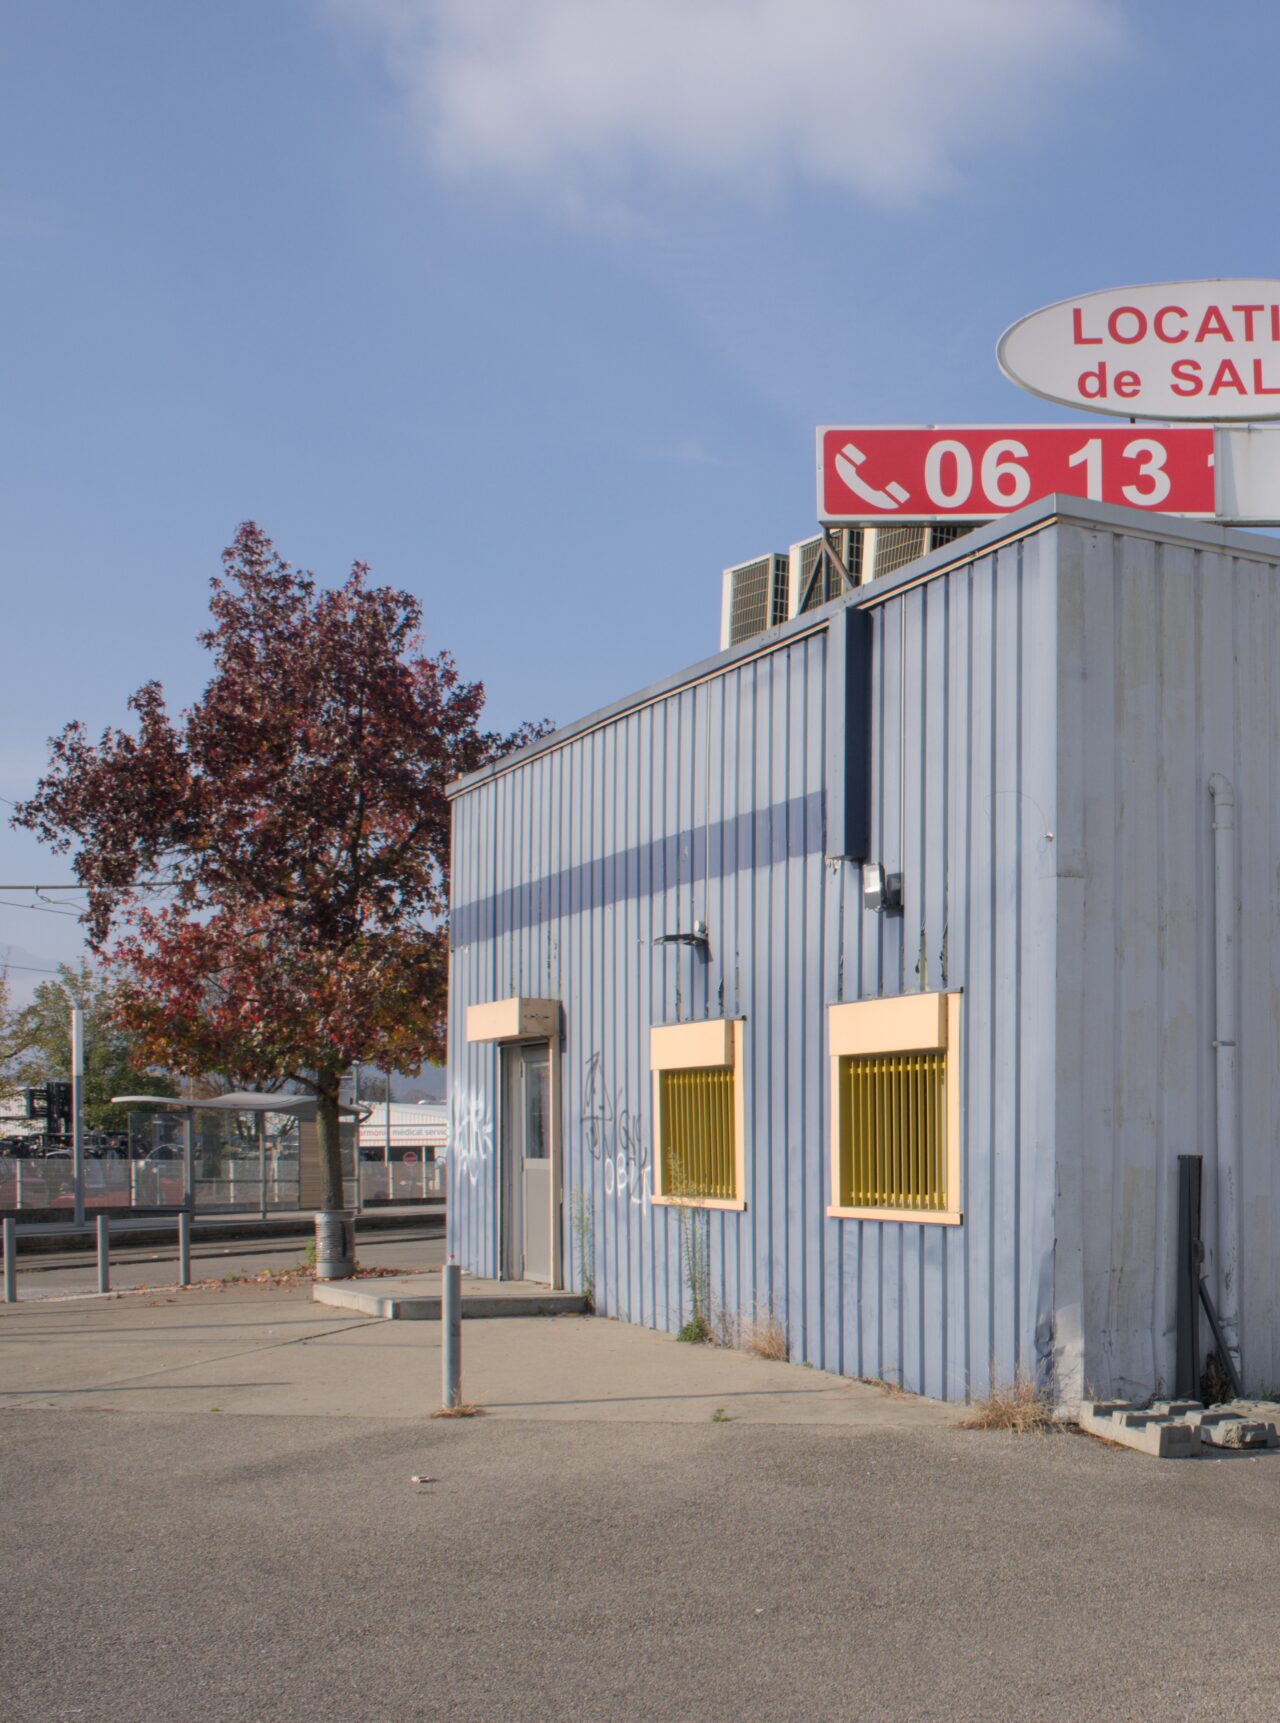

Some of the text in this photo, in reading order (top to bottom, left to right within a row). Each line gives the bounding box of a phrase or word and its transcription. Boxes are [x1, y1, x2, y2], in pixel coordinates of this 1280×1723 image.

[1078, 361, 1142, 399] de
[924, 440, 1031, 509] 06
[1069, 438, 1171, 506] 13
